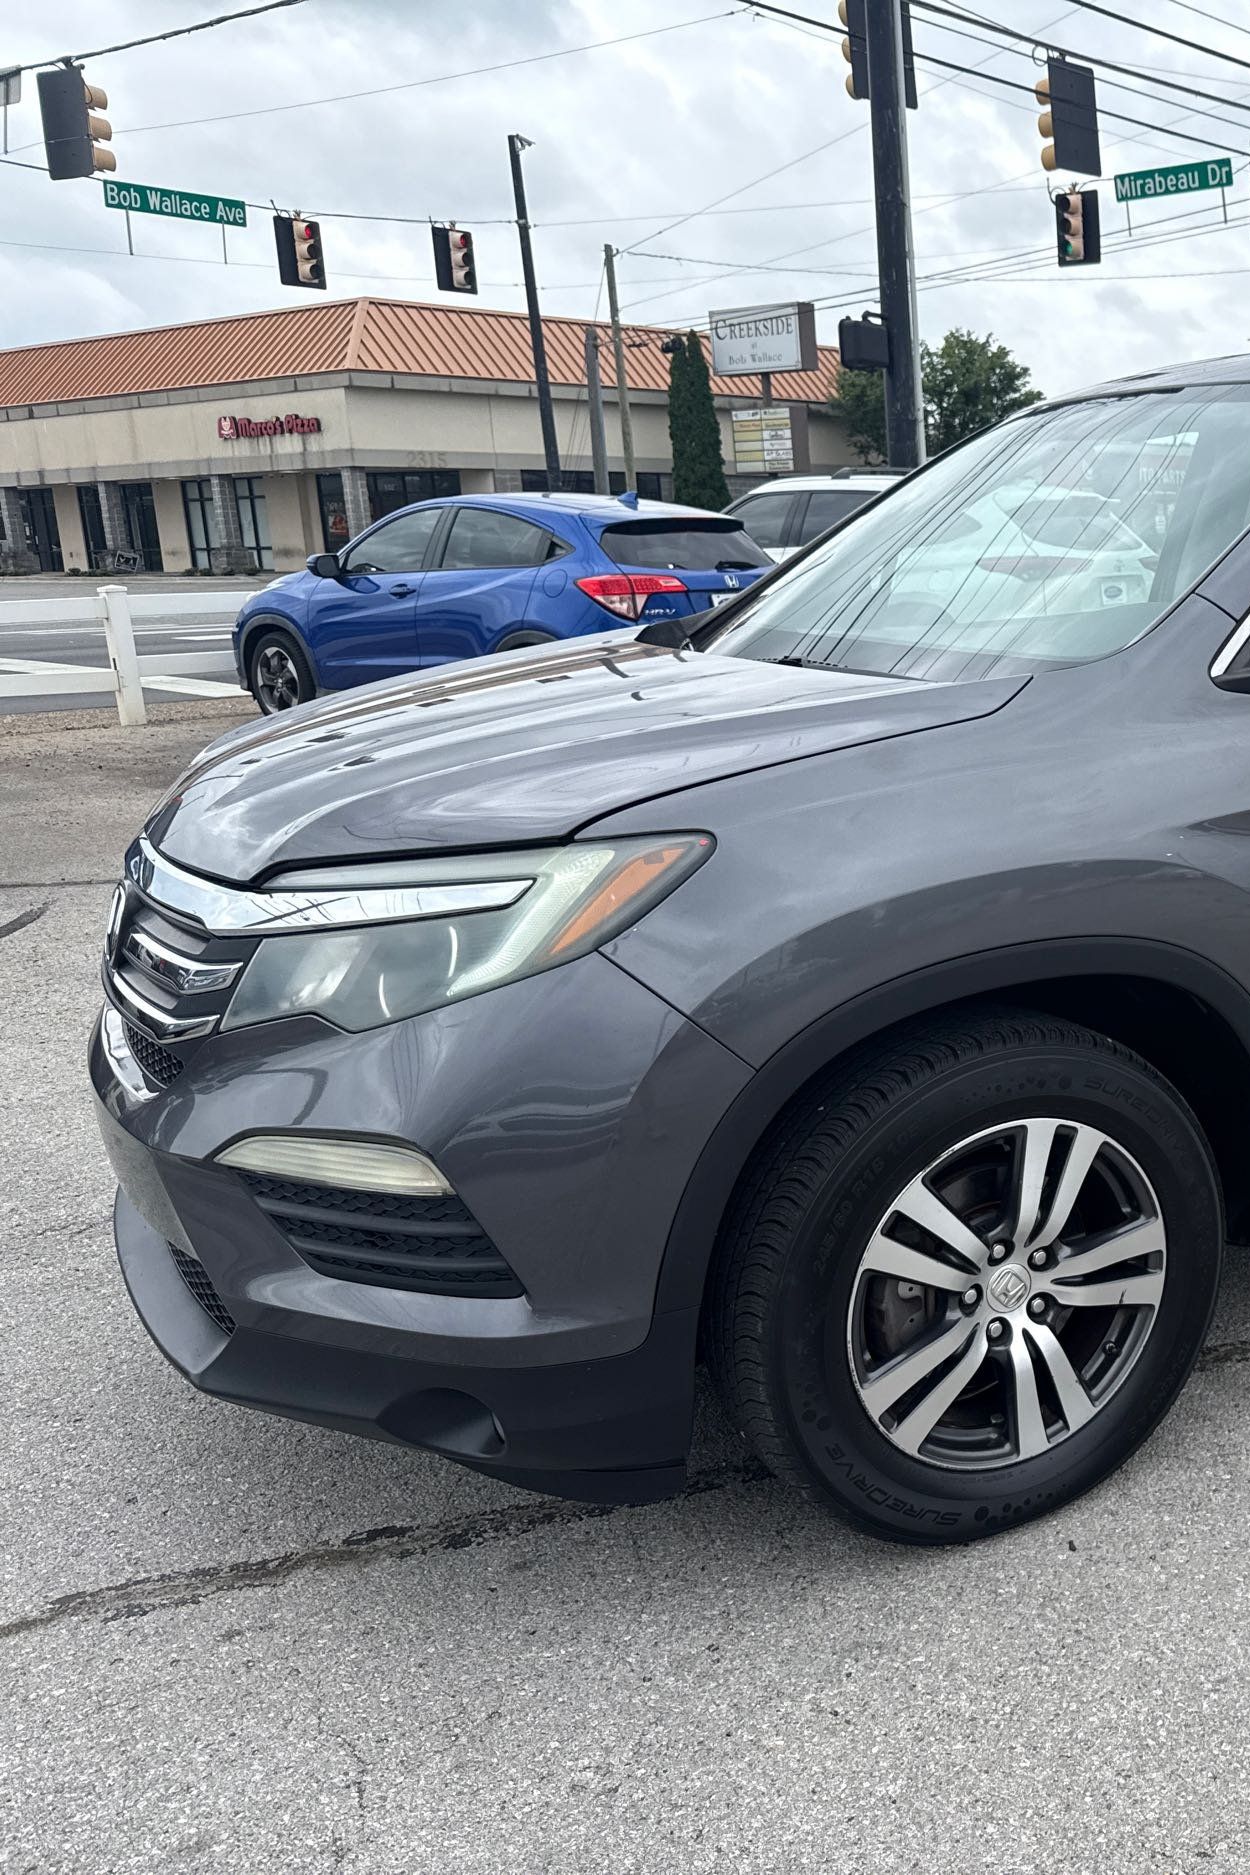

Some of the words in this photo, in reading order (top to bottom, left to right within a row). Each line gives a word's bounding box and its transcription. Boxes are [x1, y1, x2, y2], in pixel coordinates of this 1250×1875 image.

[1116, 170, 1199, 199] Mirabeau
[1207, 163, 1229, 186] Dr
[106, 183, 141, 208] Bob
[146, 189, 210, 218] Wallace
[216, 201, 244, 223] Ave
[715, 317, 793, 340] CREEKSIDE
[729, 355, 747, 365] Bob
[751, 352, 782, 363] Wallace
[237, 416, 284, 438] Marco's
[284, 414, 321, 434] Pizza
[407, 450, 449, 468] 2315
[825, 1443, 963, 1526] SUREDRIVE
